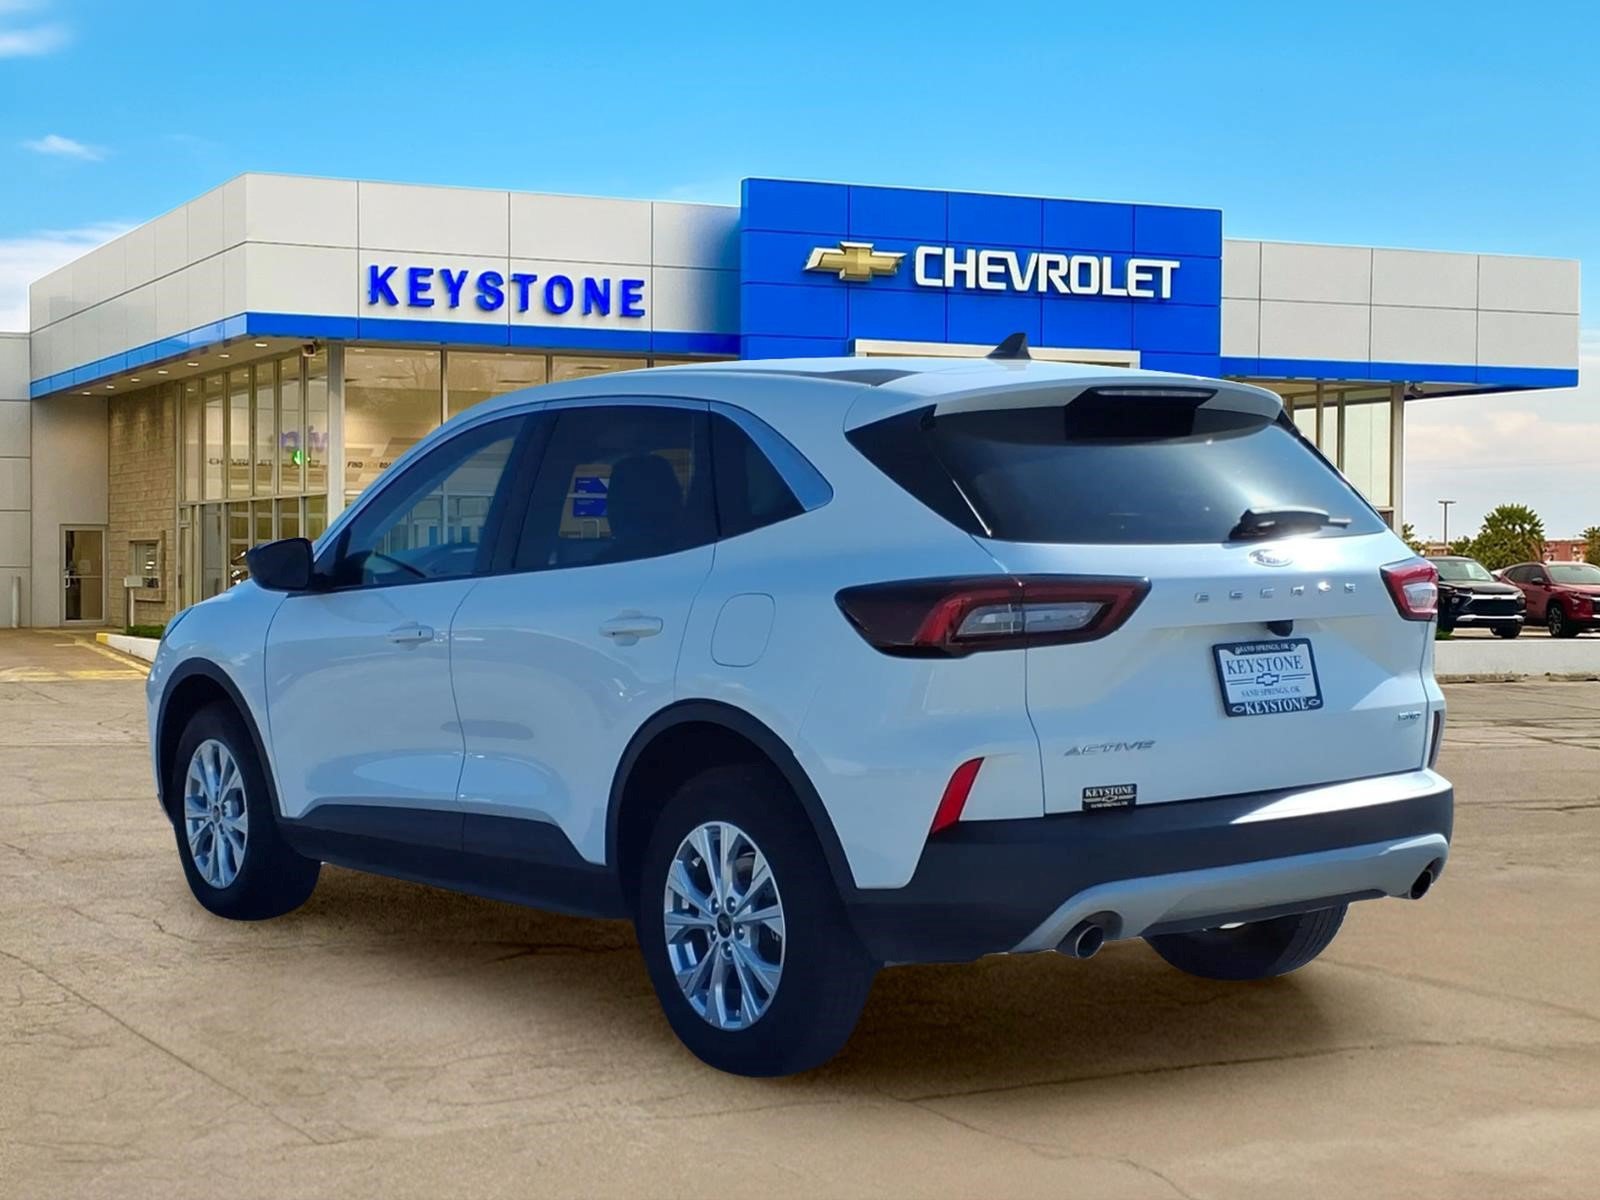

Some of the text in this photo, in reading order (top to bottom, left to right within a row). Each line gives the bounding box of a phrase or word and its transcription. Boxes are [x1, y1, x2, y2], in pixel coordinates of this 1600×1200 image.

[915, 245, 1180, 299] CHEVROLET
[367, 265, 645, 317] KEYSTONE
[1225, 655, 1304, 675] KEYSTONE
[1245, 697, 1308, 715] KEYSTONE
[1063, 740, 1156, 756] ACTIVE
[1085, 785, 1134, 798] KEYSTONE
